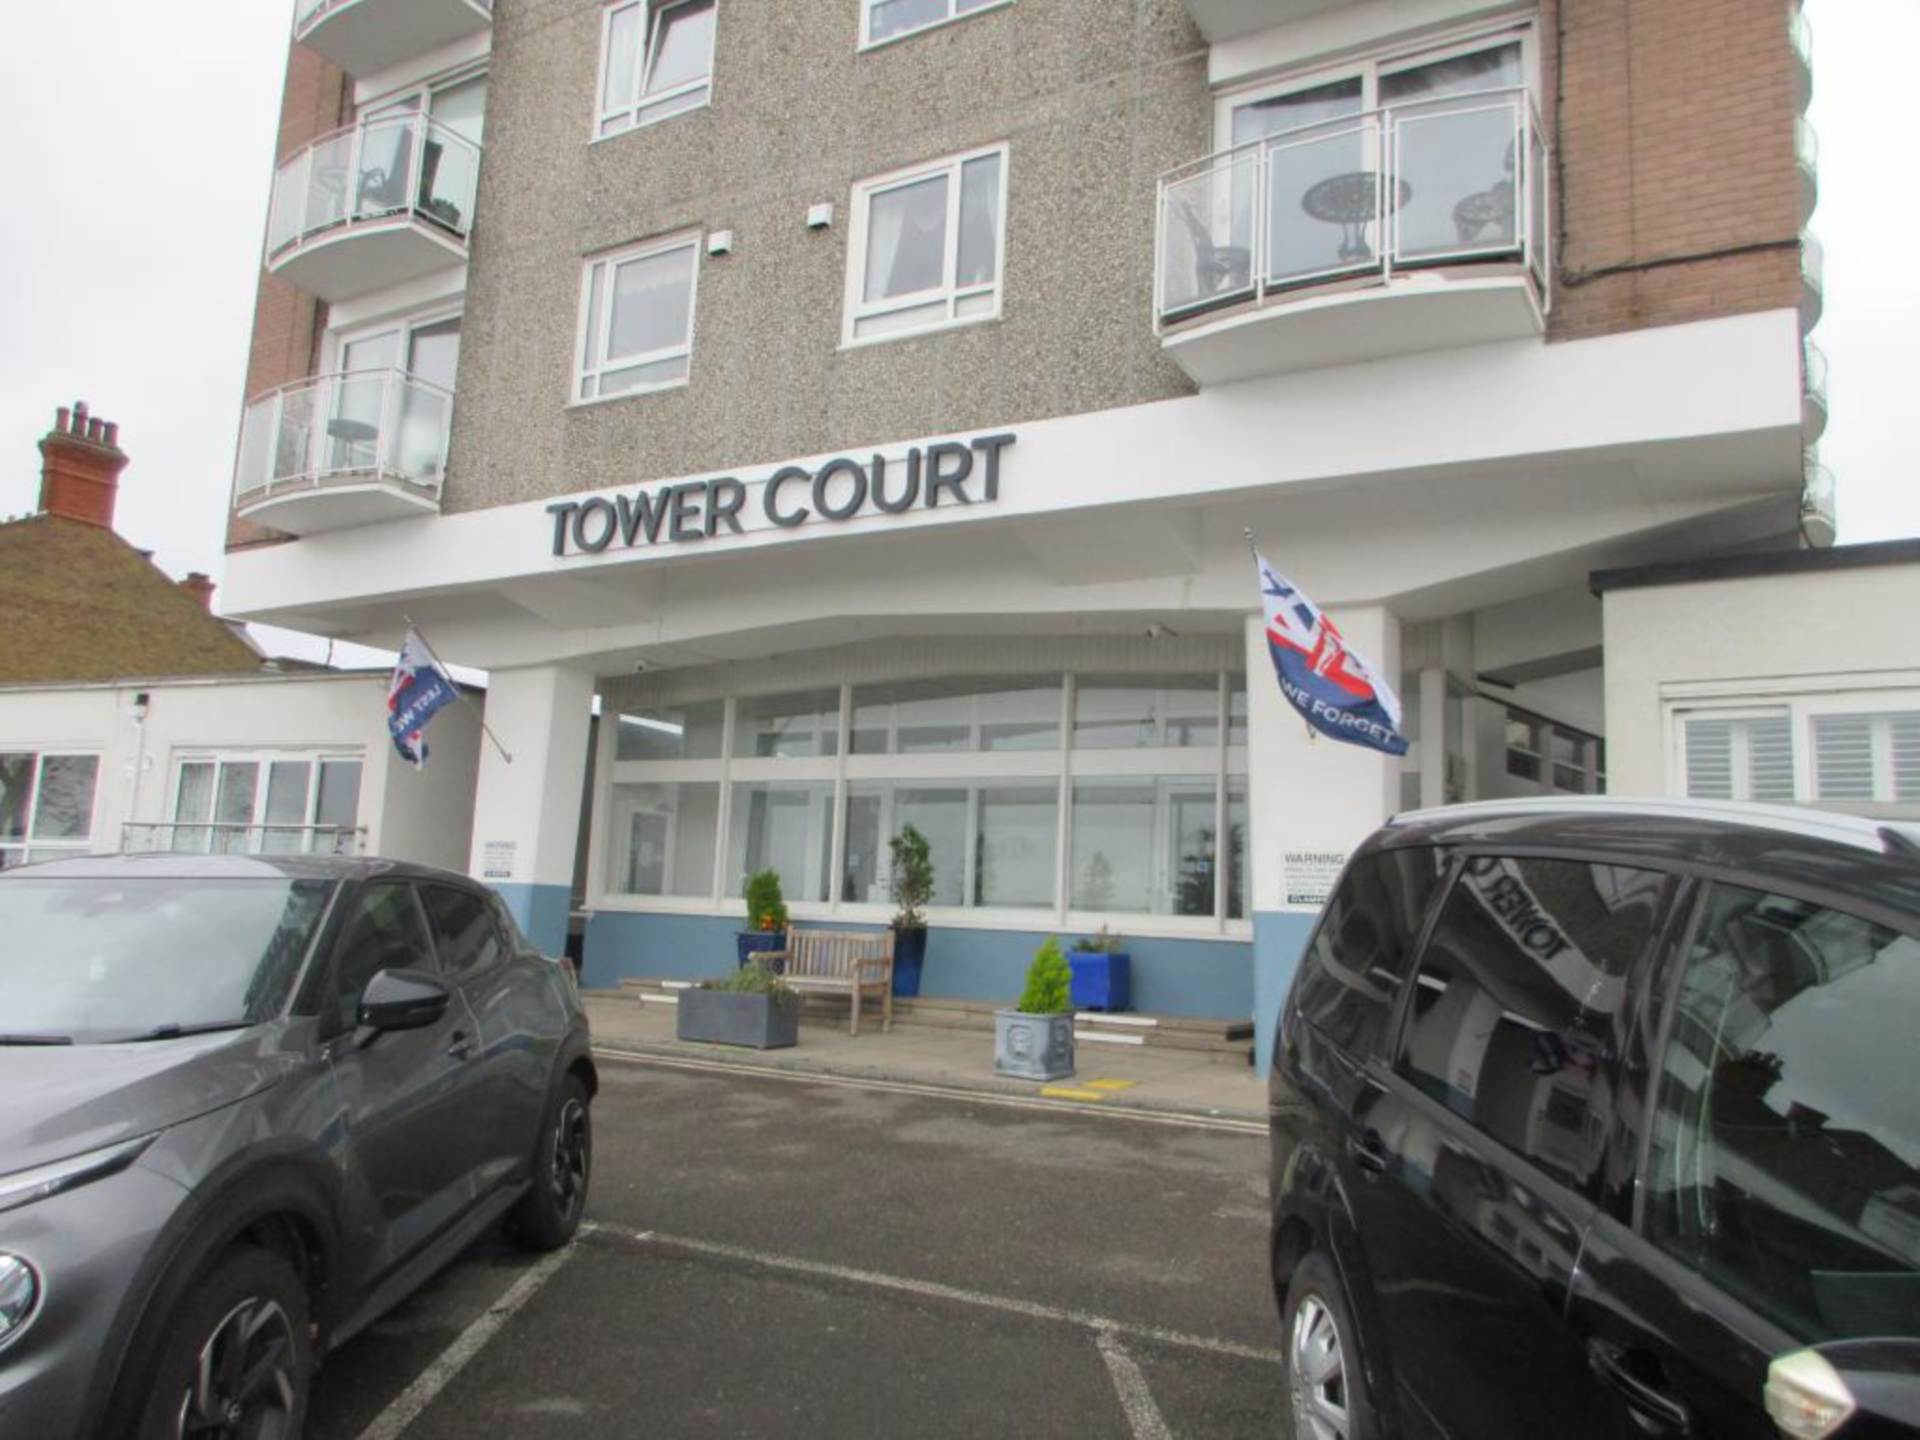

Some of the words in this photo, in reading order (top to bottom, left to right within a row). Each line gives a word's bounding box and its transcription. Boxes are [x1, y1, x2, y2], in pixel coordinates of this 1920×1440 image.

[546, 477, 747, 556] TOWER
[763, 433, 1017, 528] COURT
[1281, 678, 1310, 708] WE
[1312, 699, 1394, 744] FORGET
[1284, 852, 1345, 865] WARNING
